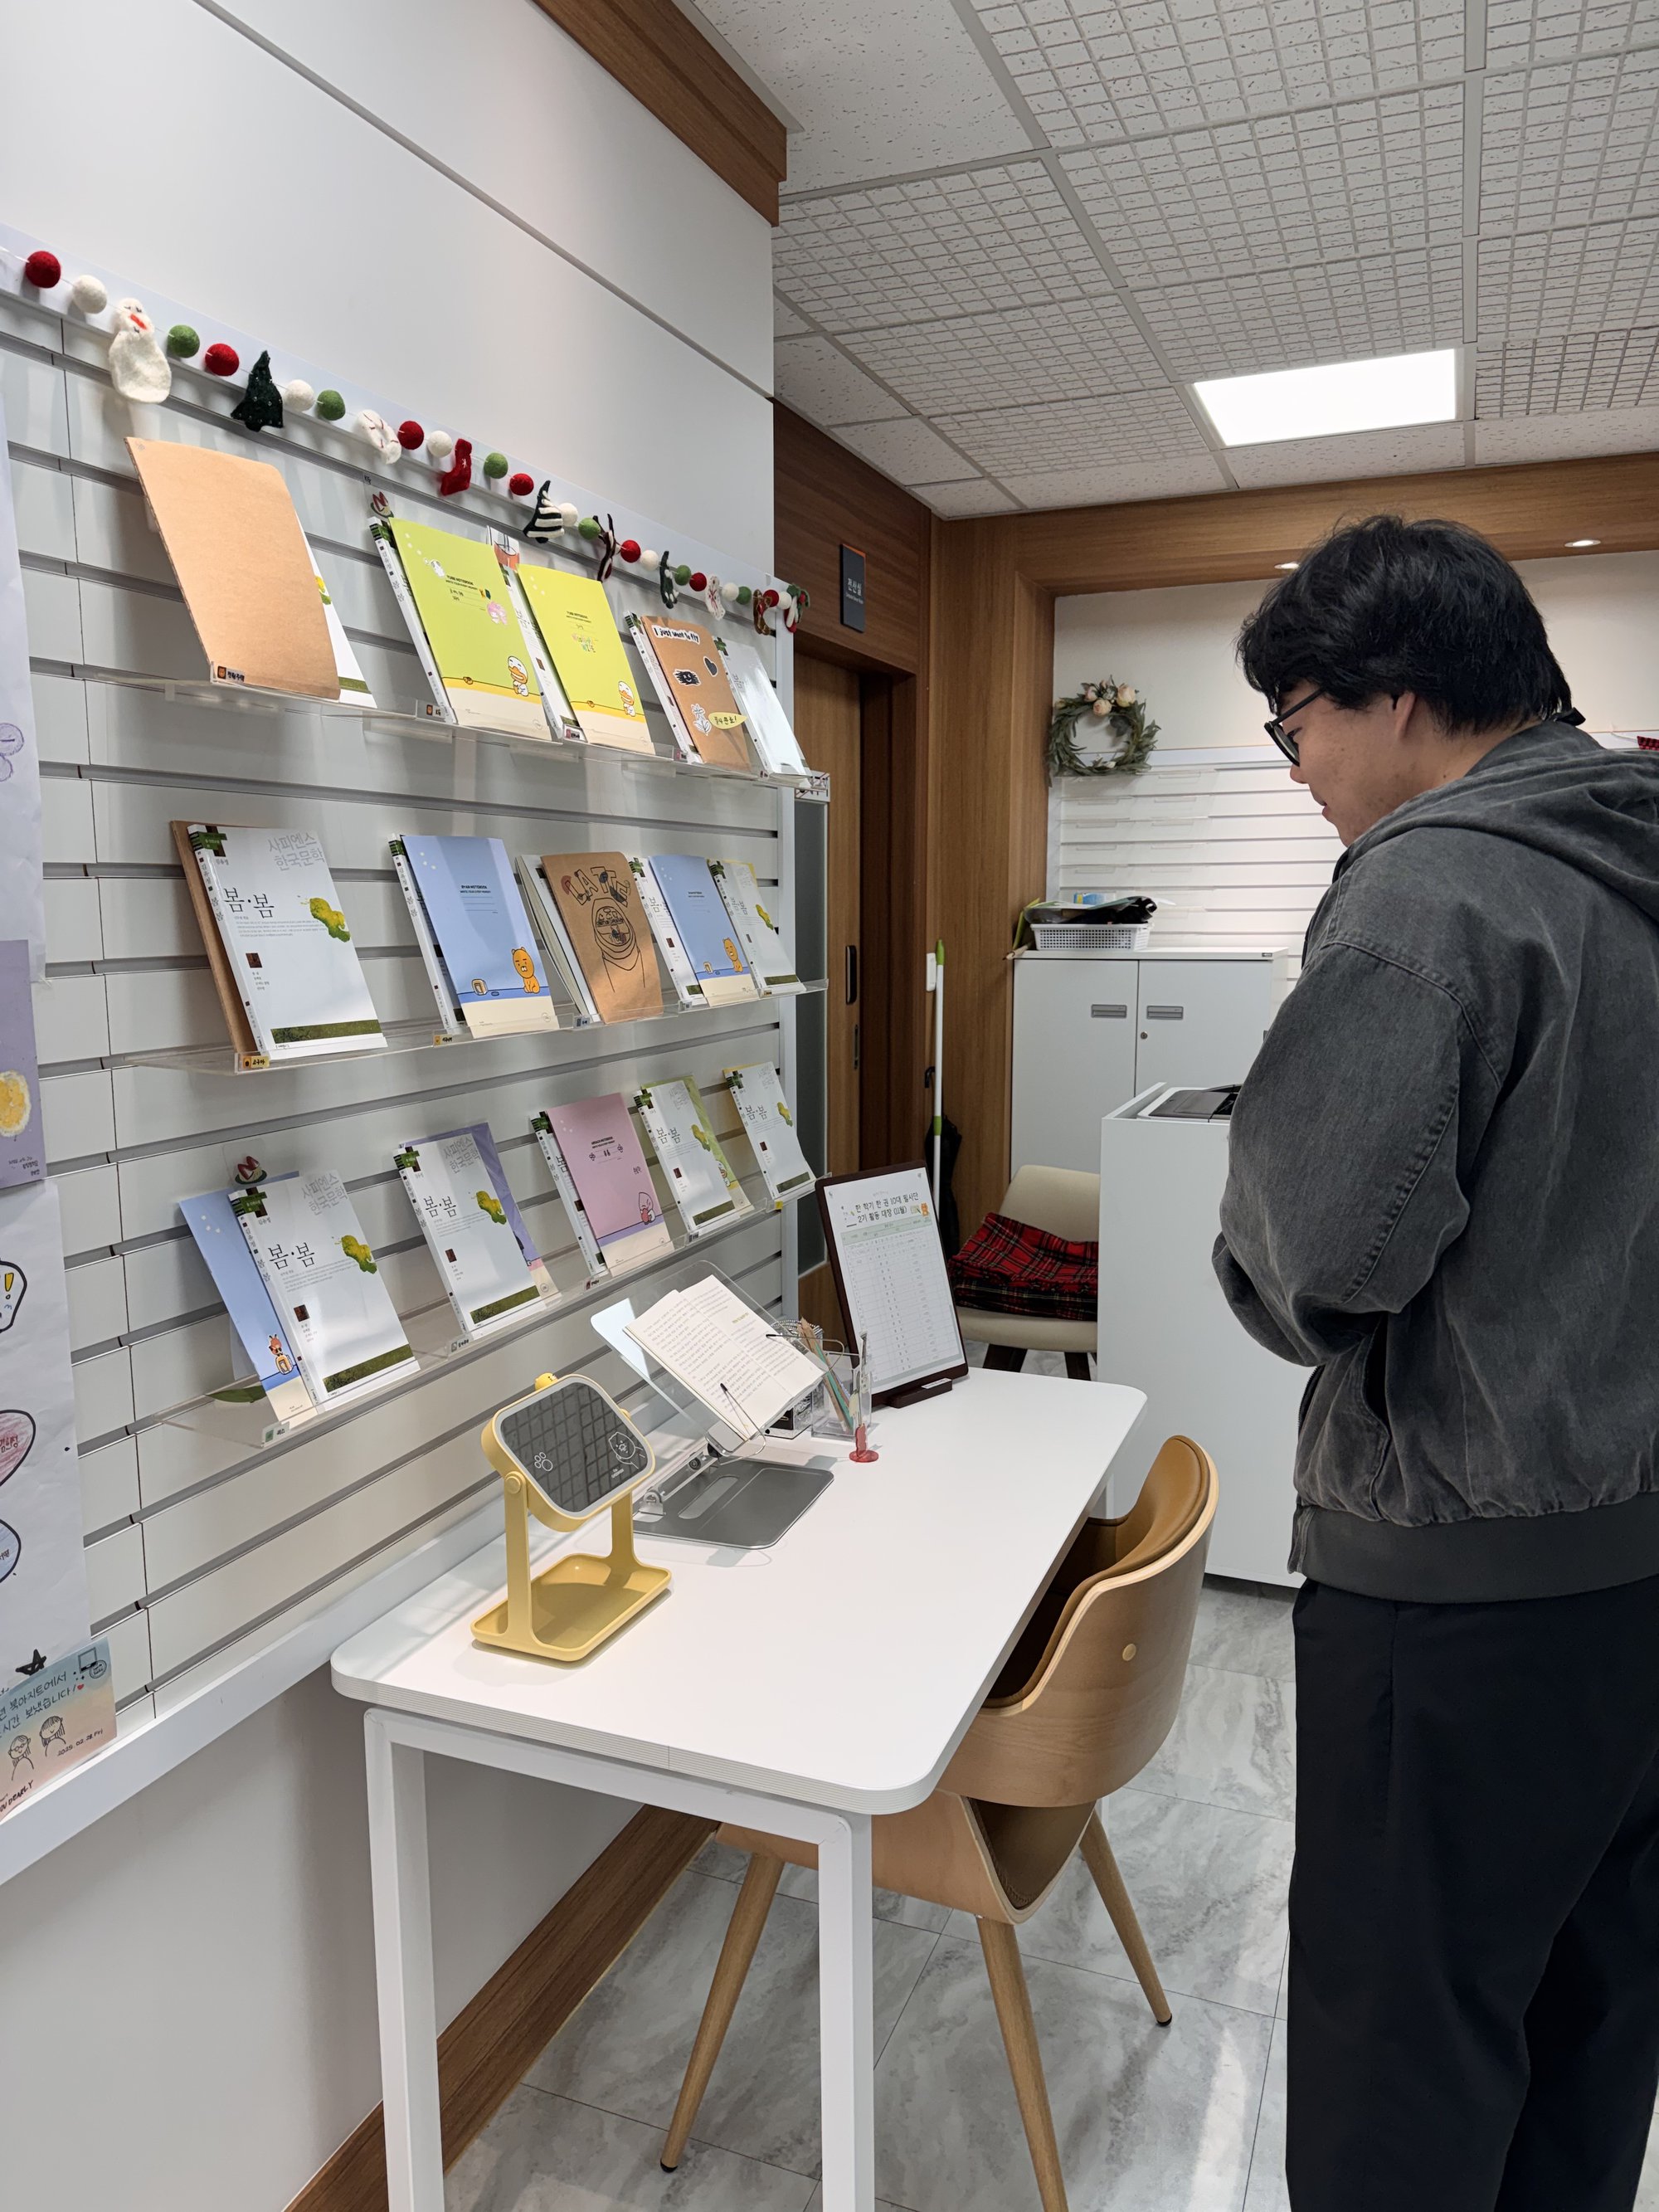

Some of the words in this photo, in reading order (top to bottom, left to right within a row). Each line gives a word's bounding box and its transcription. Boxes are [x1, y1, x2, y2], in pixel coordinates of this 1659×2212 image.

[654, 627, 658, 636] I
[659, 627, 672, 637] just
[684, 631, 690, 640] to
[691, 633, 699, 643] fly
[268, 832, 317, 854] 사피엔스
[275, 847, 325, 871] 한국문학
[223, 887, 275, 918] 봄·봄
[444, 1137, 474, 1159] 사피엔스
[450, 1150, 481, 1174] 한국문학
[301, 1173, 339, 1200] 사피엔스
[309, 1186, 348, 1216] 한국문학
[423, 1196, 457, 1217] 봄·봄
[855, 1205, 861, 1213] 한
[863, 1201, 874, 1211] 학기
[876, 1199, 882, 1209] 한
[883, 1198, 889, 1207] 권
[890, 1196, 902, 1205] 10대
[902, 1191, 919, 1203] 필사단
[858, 1213, 868, 1223] 2기
[868, 1211, 879, 1221] 활동
[881, 1208, 892, 1218] 대장
[268, 1242, 315, 1269] 봄·봄
[9, 1670, 66, 1711] 북아지트에서
